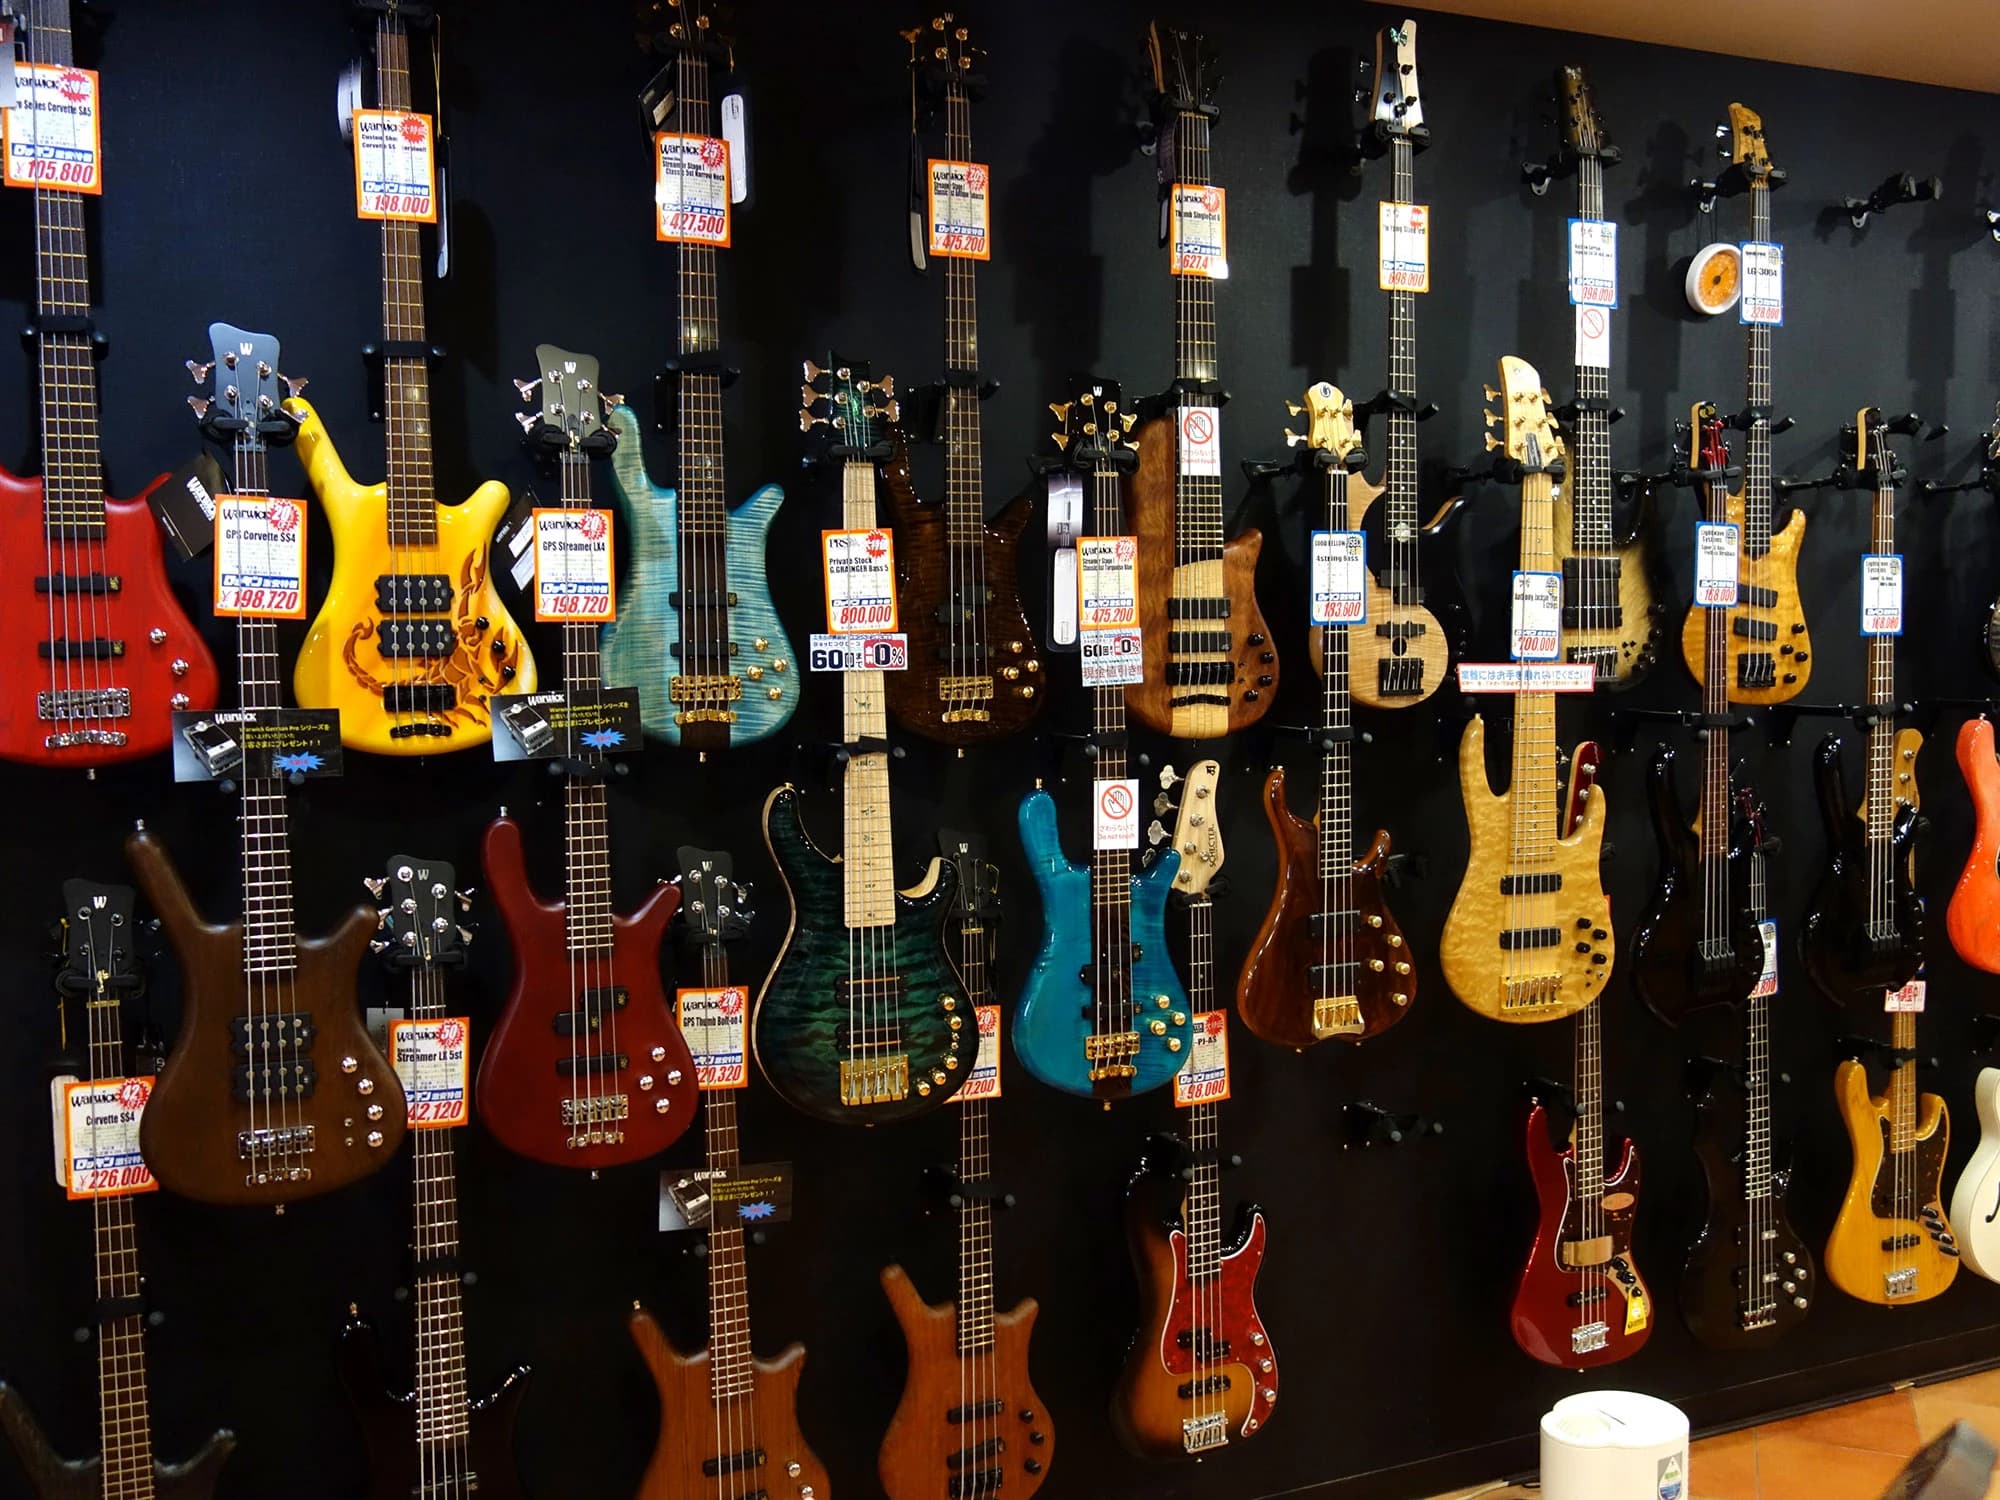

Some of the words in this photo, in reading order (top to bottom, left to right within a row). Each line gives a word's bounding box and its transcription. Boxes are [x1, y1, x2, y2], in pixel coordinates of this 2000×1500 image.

[47, 101, 77, 114] Corvette
[375, 194, 430, 214] 198,000
[670, 212, 725, 234] 427,500
[942, 233, 985, 252] 475,200
[225, 530, 242, 539] GPS
[243, 530, 278, 542] Corvette
[280, 532, 296, 543] SS4
[543, 541, 556, 551] GPS
[558, 541, 591, 551] Streamer
[593, 542, 605, 552] LX4
[829, 557, 852, 565] Private
[234, 589, 298, 610] 198,720
[552, 595, 609, 614] 198,720
[840, 605, 892, 625] 800,000
[1092, 607, 1133, 624] 475,200
[527, 691, 565, 706] Warwick
[417, 868, 429, 880] W
[93, 896, 107, 909] W
[397, 1052, 437, 1063] Streamer
[449, 1050, 463, 1060] 5st
[1187, 1079, 1225, 1099] 98,000
[86, 1114, 118, 1126] Corvette
[120, 1111, 135, 1122] SS4
[88, 1165, 151, 1190] 226,000
